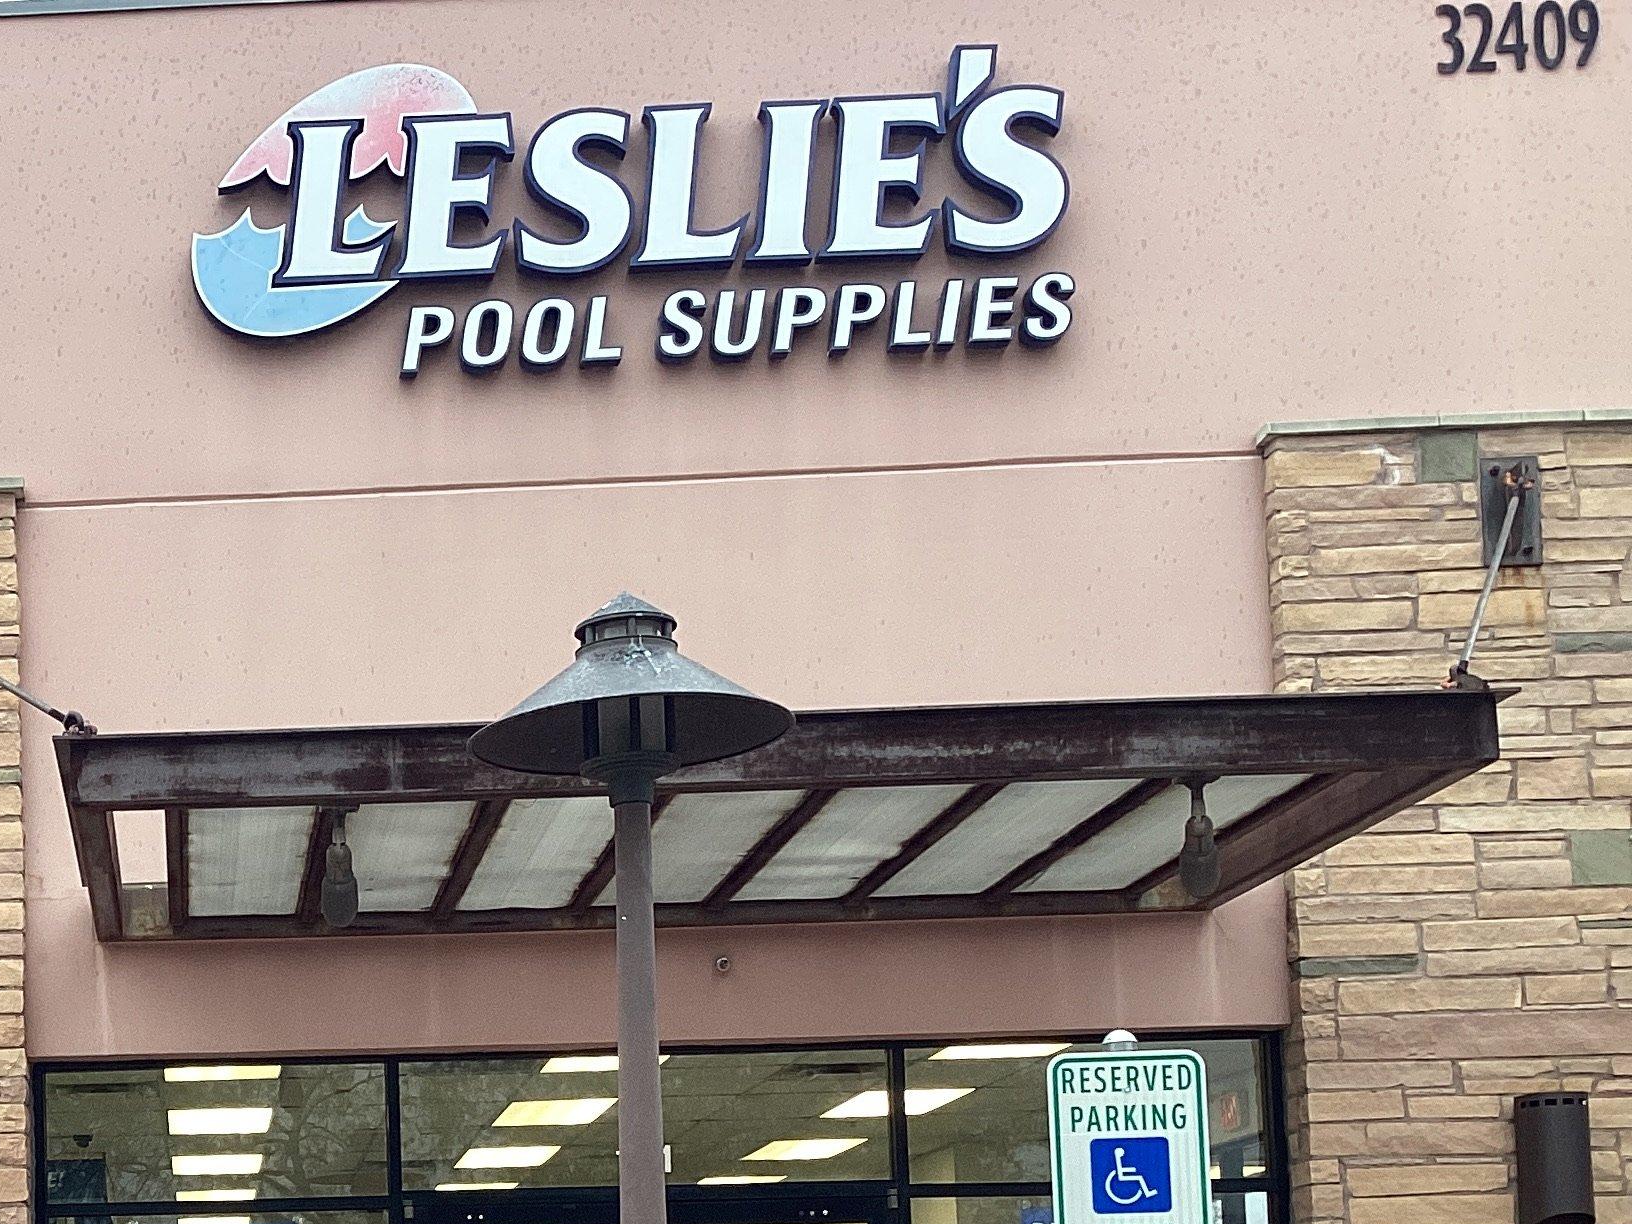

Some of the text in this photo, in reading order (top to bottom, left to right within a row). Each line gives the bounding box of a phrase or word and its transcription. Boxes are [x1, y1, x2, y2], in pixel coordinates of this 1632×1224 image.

[1435, 0, 1600, 75] 32409
[272, 43, 1070, 287] LESLIE'S
[399, 272, 1075, 380] POOL SUPPLIES
[1060, 1064, 1192, 1095] RESERVED
[1070, 1103, 1187, 1133] PARKING
